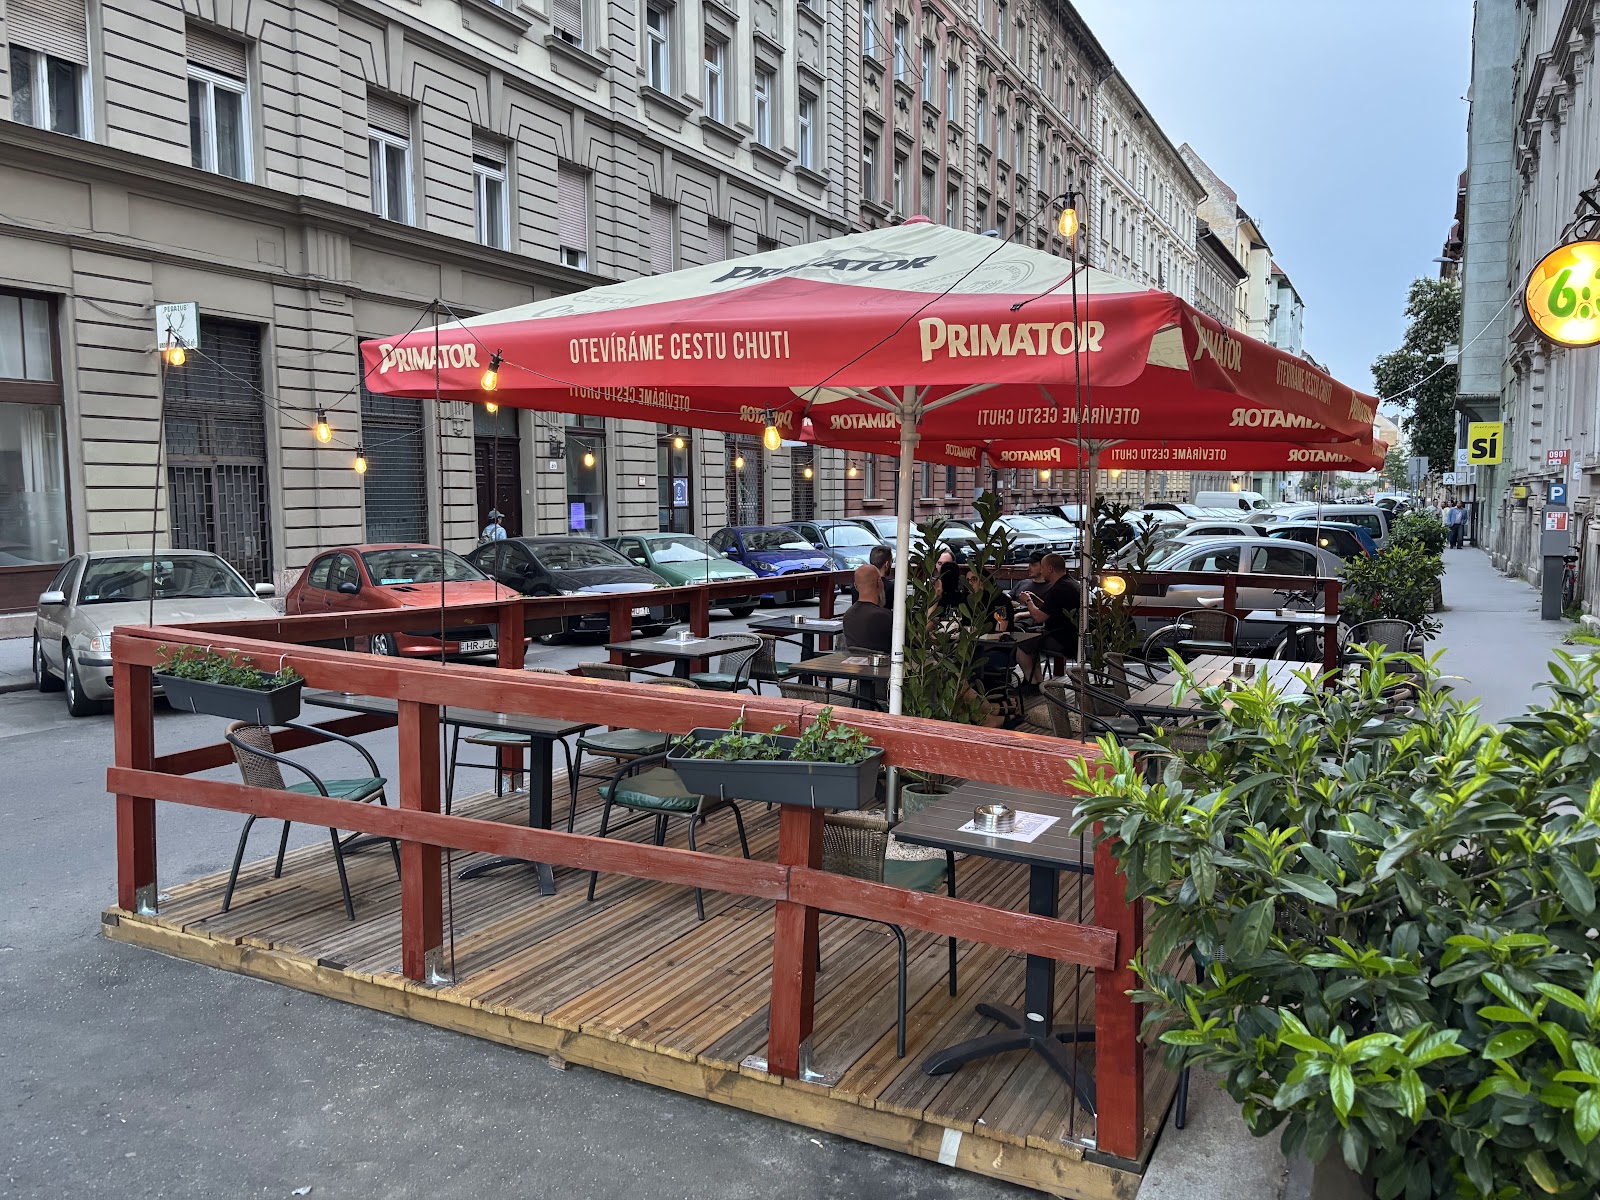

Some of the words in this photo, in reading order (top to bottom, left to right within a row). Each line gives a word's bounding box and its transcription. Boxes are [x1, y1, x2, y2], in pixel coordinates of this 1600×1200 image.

[569, 331, 665, 364] OTEVÍRÁME
[670, 331, 727, 360] CESTU
[732, 330, 791, 360] CHUTI
[918, 317, 1106, 362] PRIMATOR
[378, 343, 481, 375] PRIMATOR
[1549, 450, 1567, 459] 0901
[1550, 486, 1564, 501] P
[466, 638, 498, 651] HRJ-03
